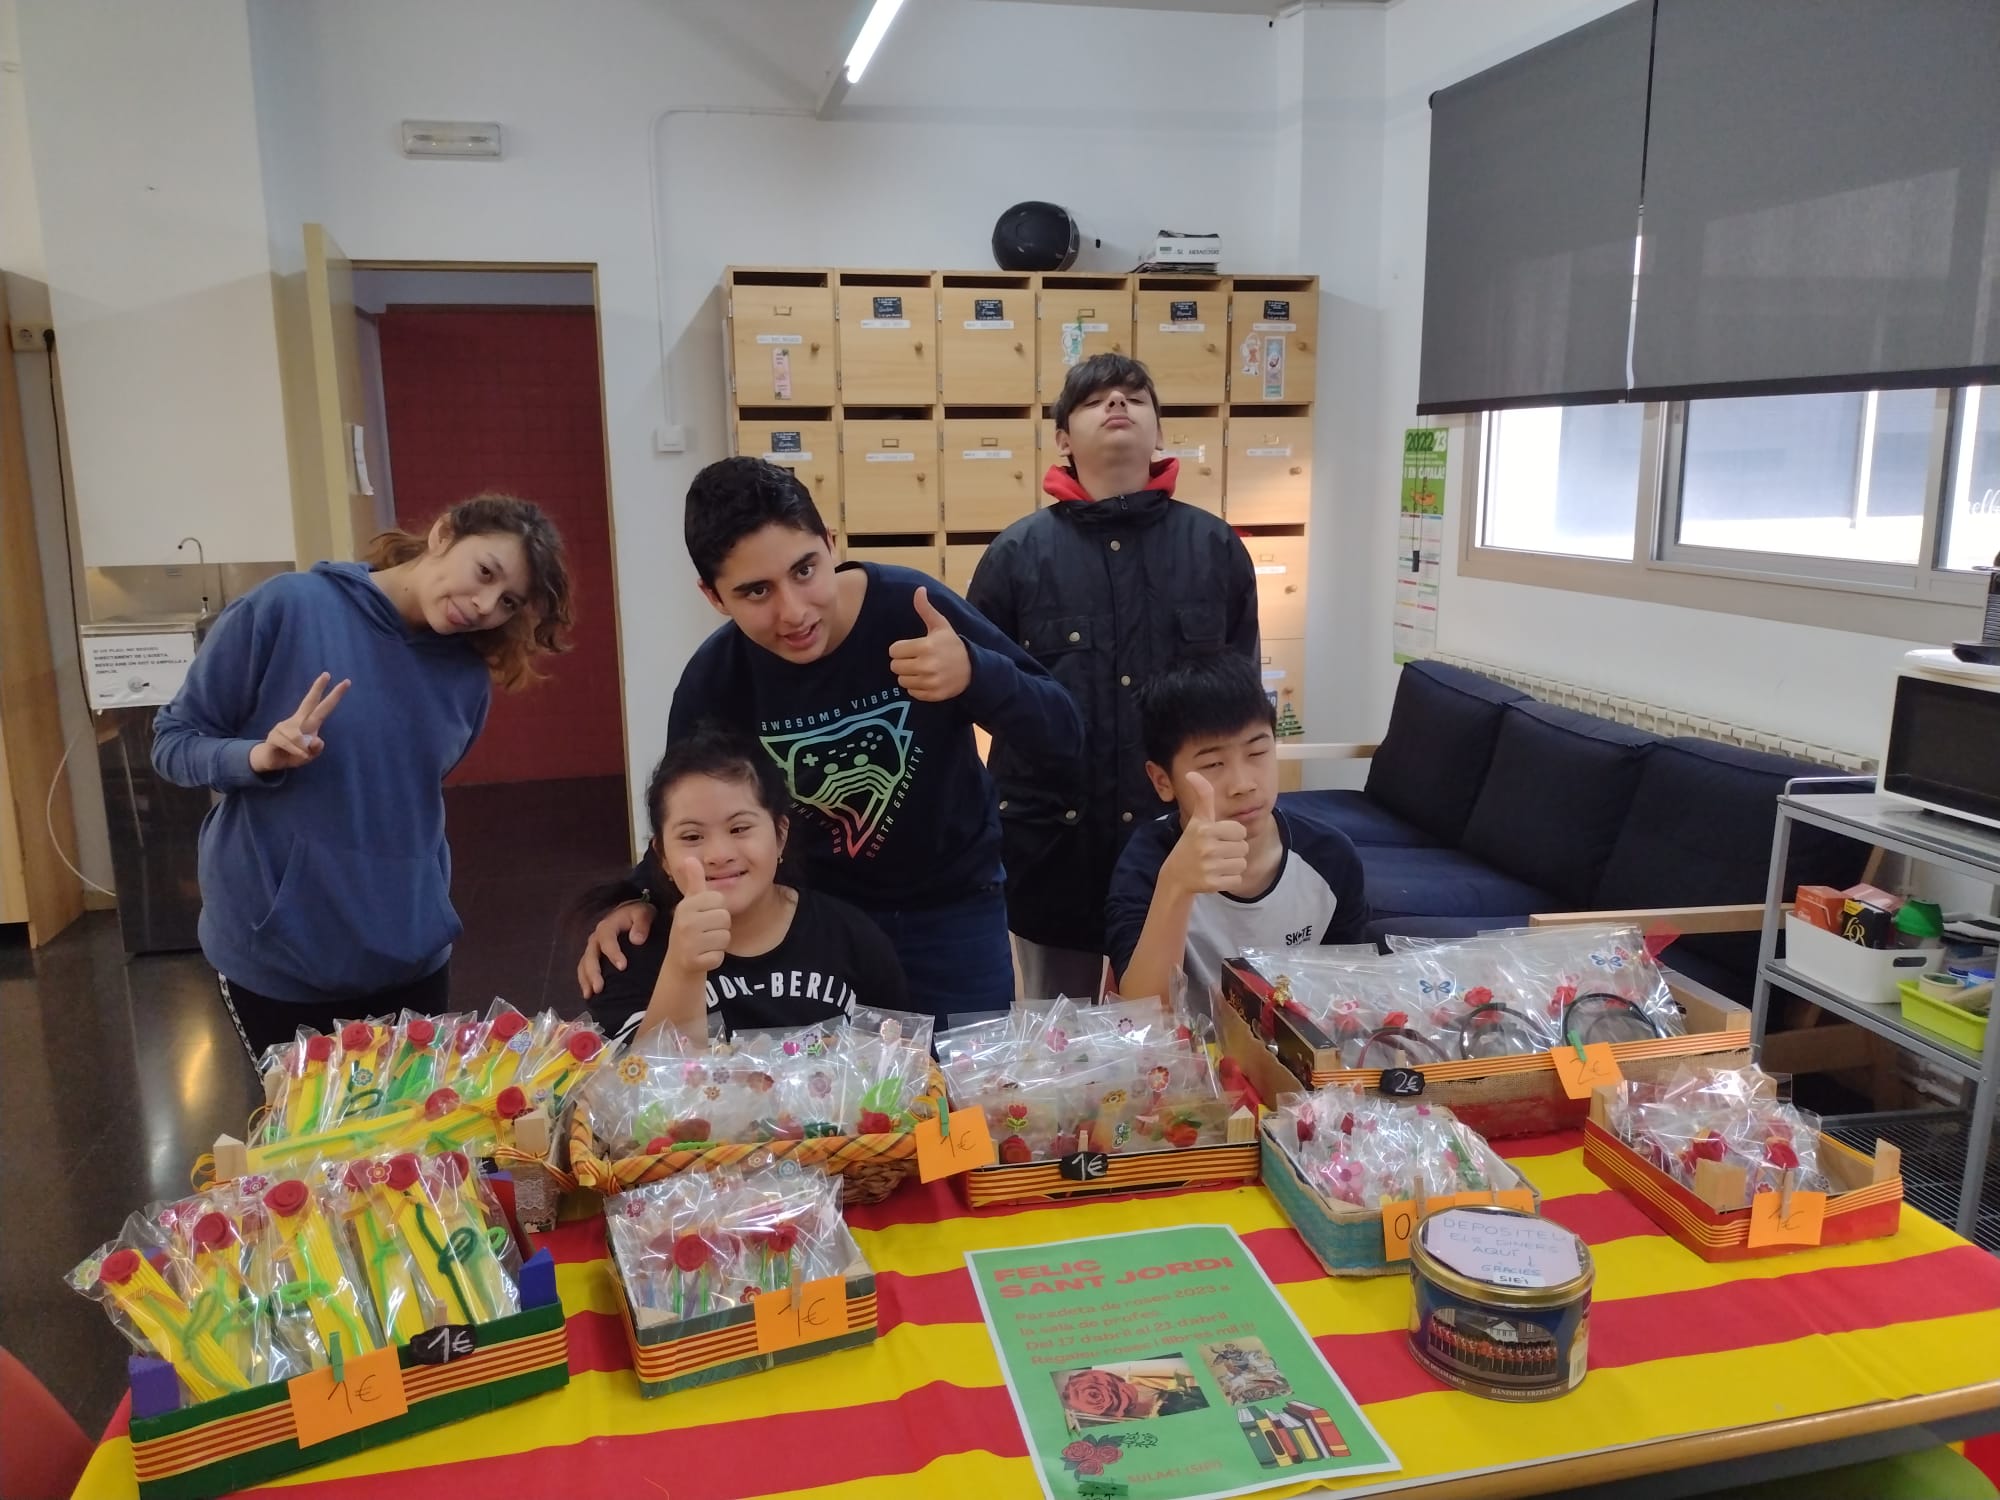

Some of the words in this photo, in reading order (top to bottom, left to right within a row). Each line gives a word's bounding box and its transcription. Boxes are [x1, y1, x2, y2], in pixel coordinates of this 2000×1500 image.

[1394, 1071, 1420, 1093] 2€
[939, 1130, 977, 1159] 1€
[1071, 1153, 1108, 1182] 1€
[999, 1274, 1106, 1299] SANT
[1114, 1256, 1235, 1285] JORDI
[776, 1297, 831, 1337] 1€
[1014, 1304, 1097, 1322] Paradeta
[1101, 1301, 1122, 1312] de
[1124, 1293, 1171, 1307] roses
[1174, 1284, 1218, 1299] 2023
[426, 1326, 475, 1364] 1€
[1025, 1339, 1055, 1352] Del
[326, 1373, 384, 1415] 1€
